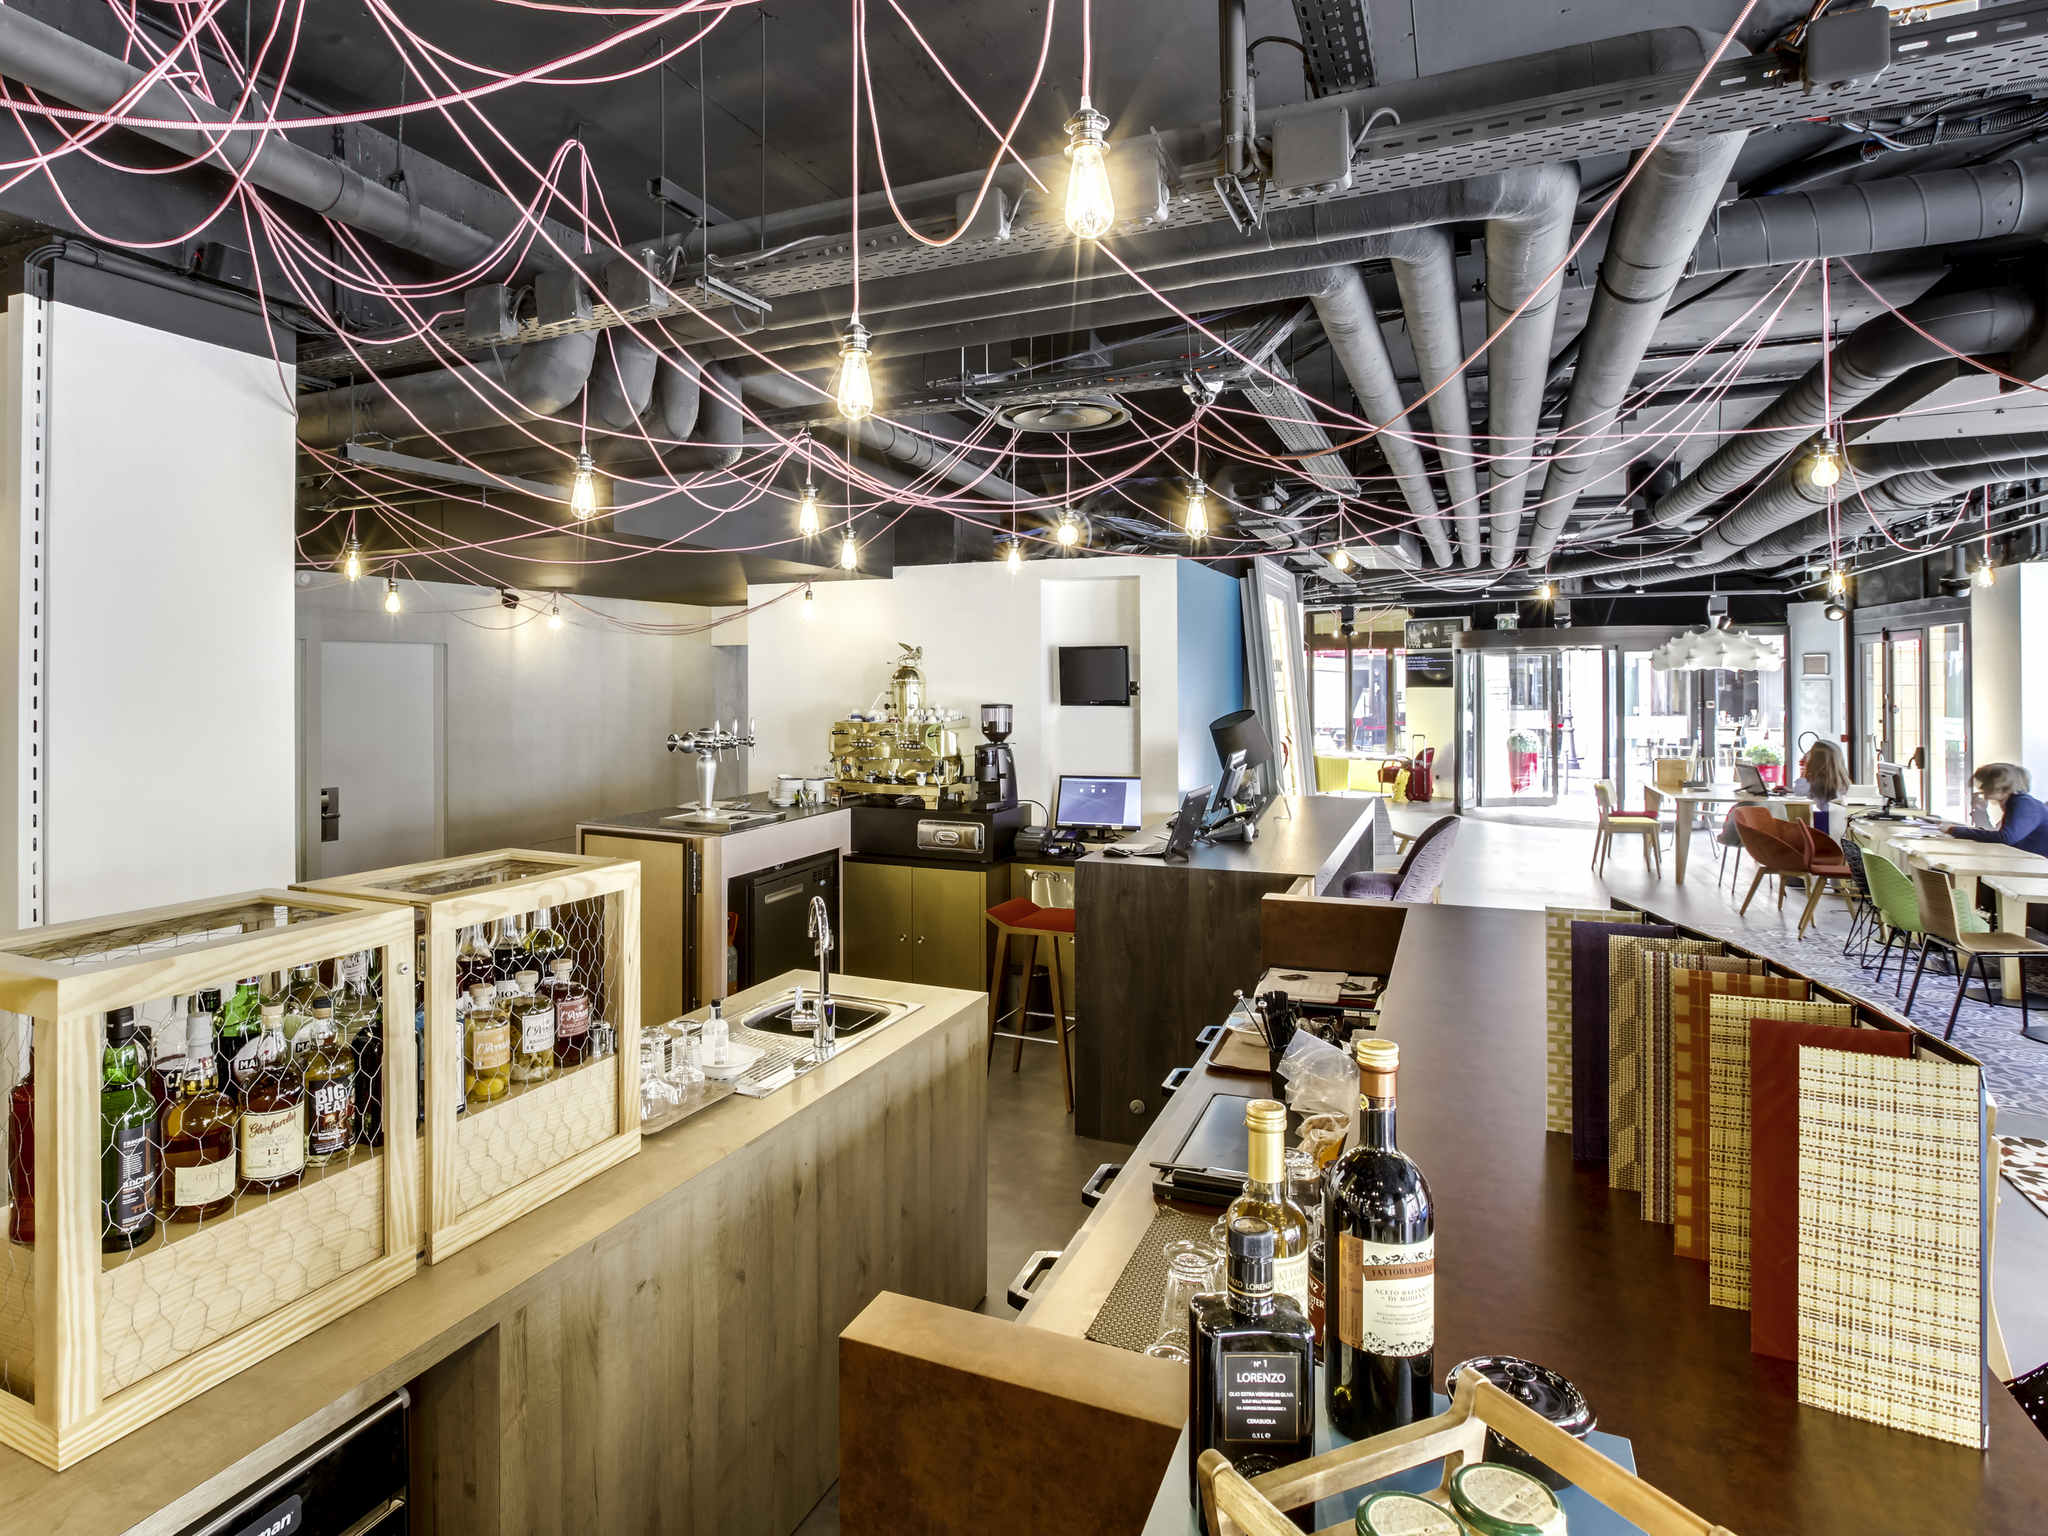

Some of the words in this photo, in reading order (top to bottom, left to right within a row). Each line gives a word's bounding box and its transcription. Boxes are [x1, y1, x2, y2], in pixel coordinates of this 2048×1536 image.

[315, 1083, 347, 1104] BIG
[316, 1100, 346, 1115] PEAT
[1236, 1372, 1286, 1384] LORENZO
